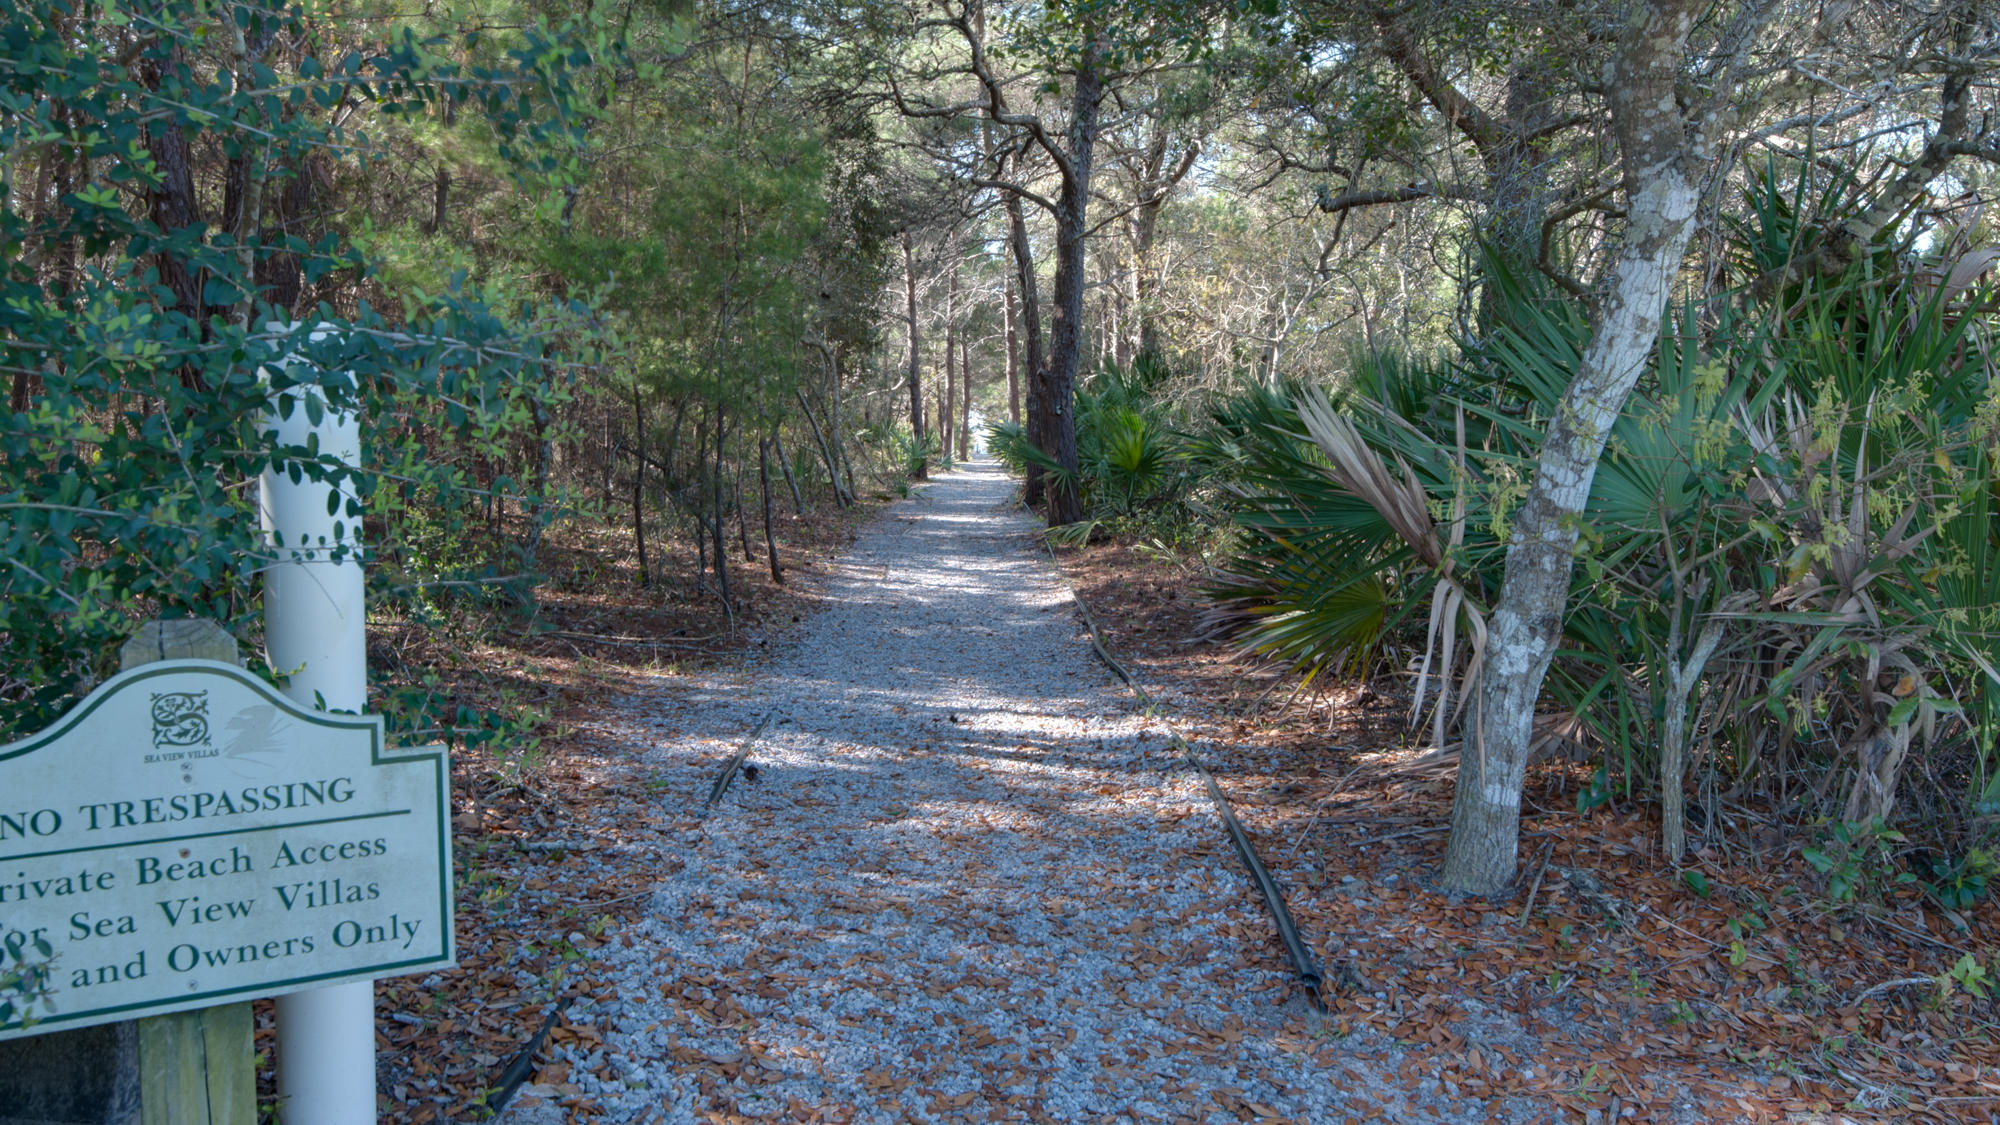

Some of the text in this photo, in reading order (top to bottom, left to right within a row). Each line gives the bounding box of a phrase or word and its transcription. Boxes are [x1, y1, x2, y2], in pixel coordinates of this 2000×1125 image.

[144, 749, 219, 764] SEA VIEW VILLAS
[0, 777, 356, 840] NO TRESPASSING
[0, 838, 387, 903] rivate Beach Access
[0, 878, 380, 949] or Sea View Villas
[71, 950, 148, 989] and
[167, 935, 315, 973] Owners
[332, 914, 422, 950] Only
